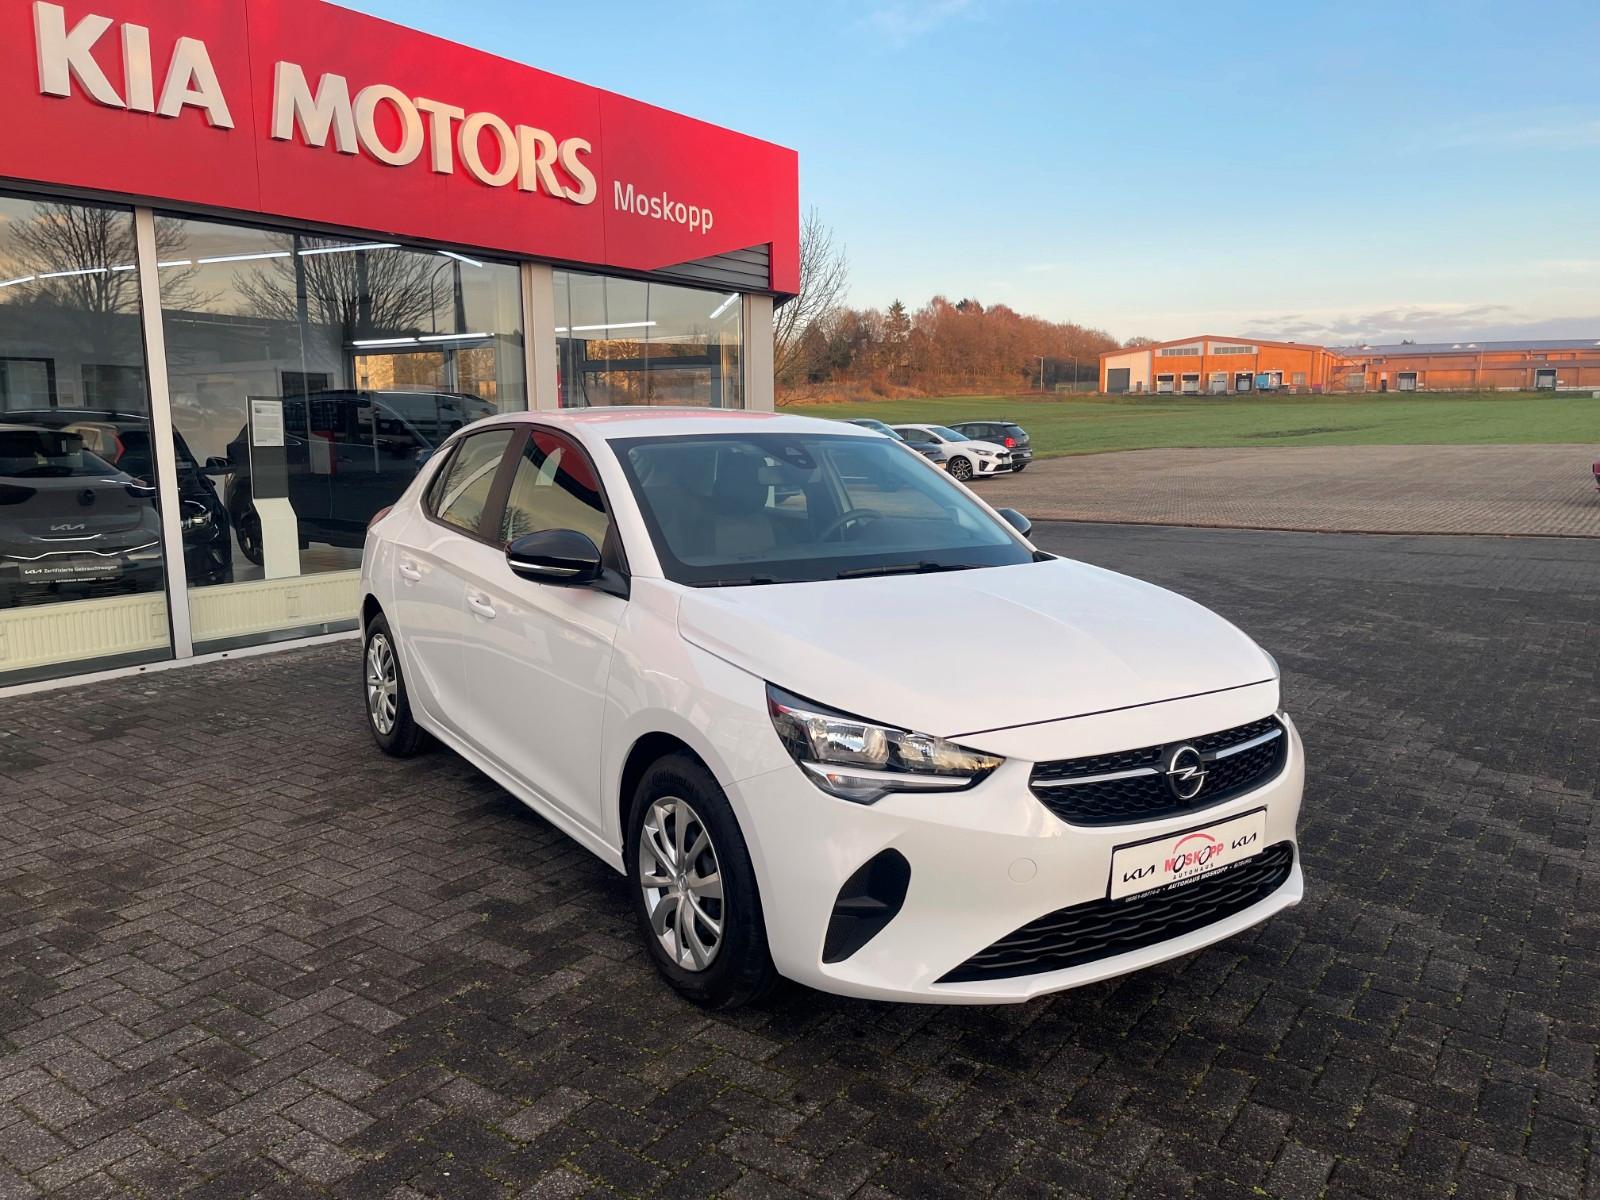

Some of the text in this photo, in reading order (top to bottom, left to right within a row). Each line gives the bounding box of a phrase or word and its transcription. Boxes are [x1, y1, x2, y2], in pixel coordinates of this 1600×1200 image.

[33, 0, 598, 206] KIA MOTORS
[612, 179, 715, 235] Moskopp
[1232, 833, 1256, 849] KIA
[1164, 843, 1224, 873] MOSKOPP
[1123, 865, 1155, 882] KIA
[1173, 863, 1214, 880] AUTOHAUS
